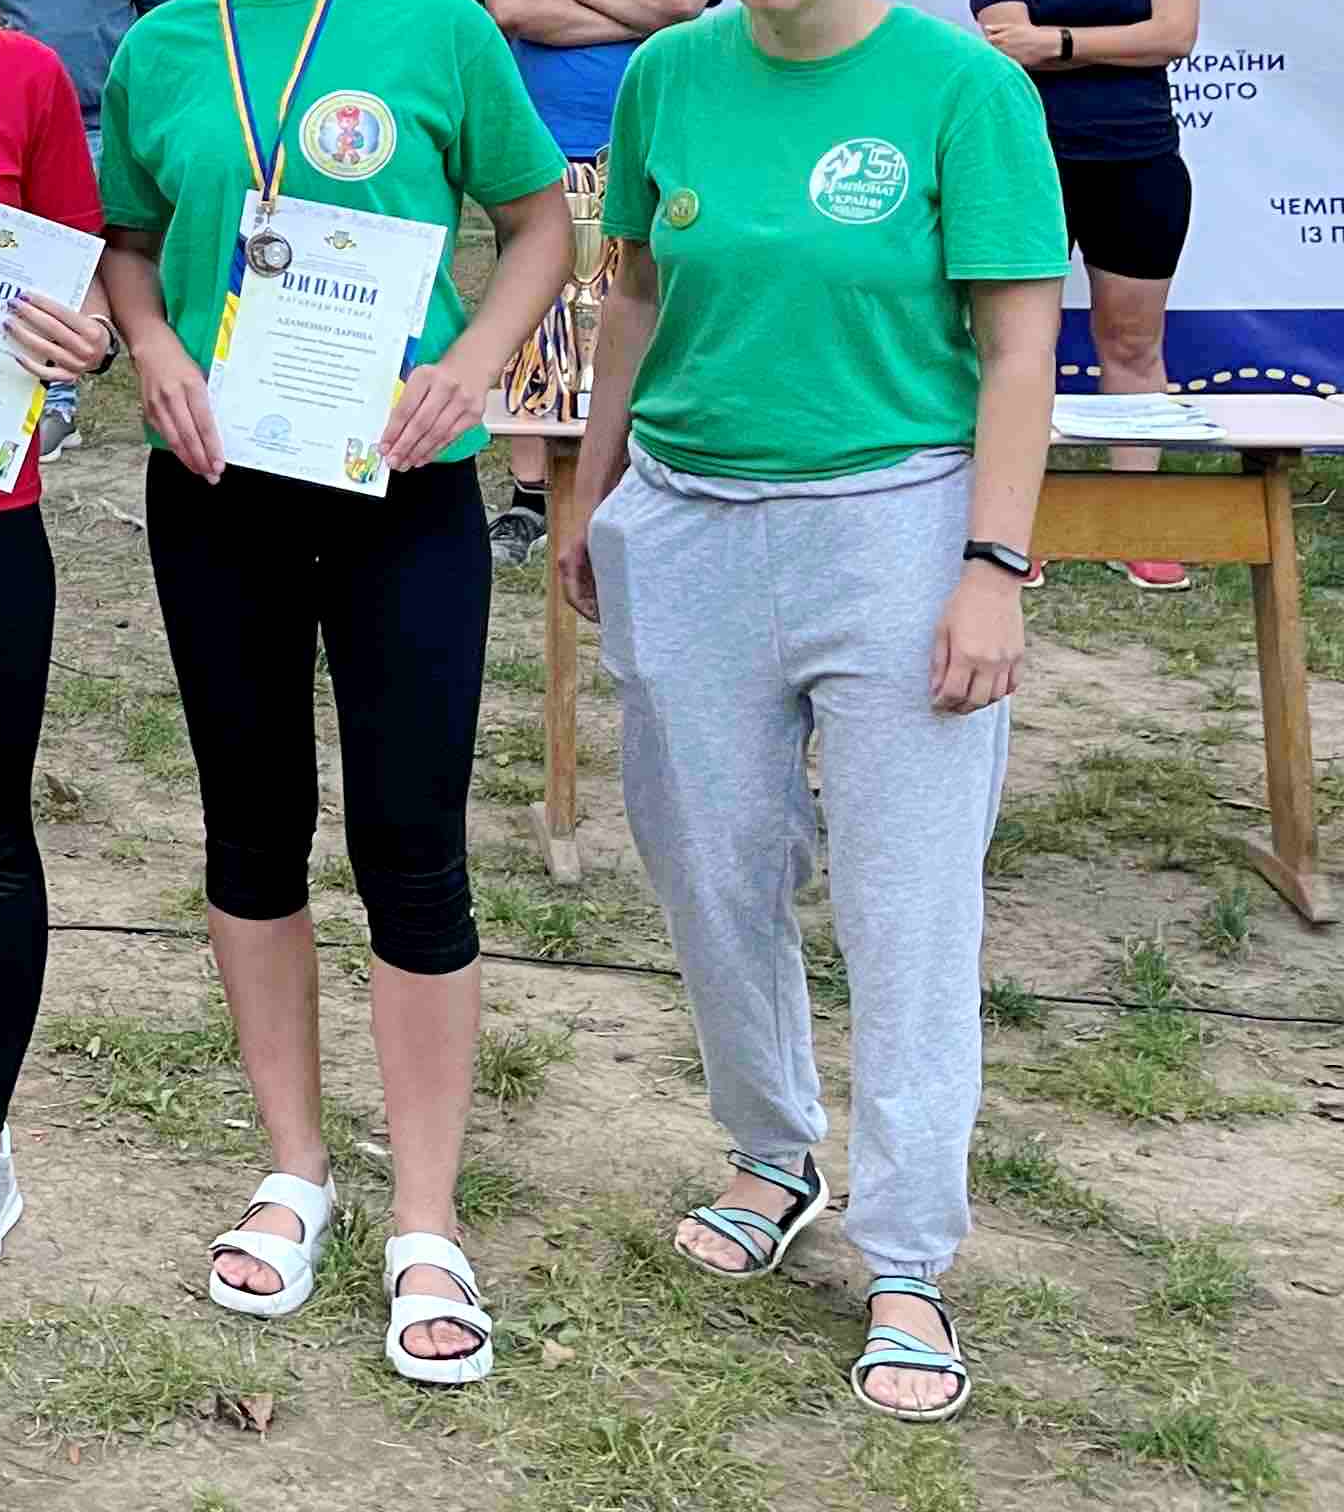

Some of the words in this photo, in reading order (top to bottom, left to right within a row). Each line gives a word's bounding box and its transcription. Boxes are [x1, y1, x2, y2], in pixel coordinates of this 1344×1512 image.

[1171, 49, 1285, 72] УКРАЇНИ
[1301, 226, 1322, 243] ІЗ
[281, 271, 379, 306] ДИПЛОМ
